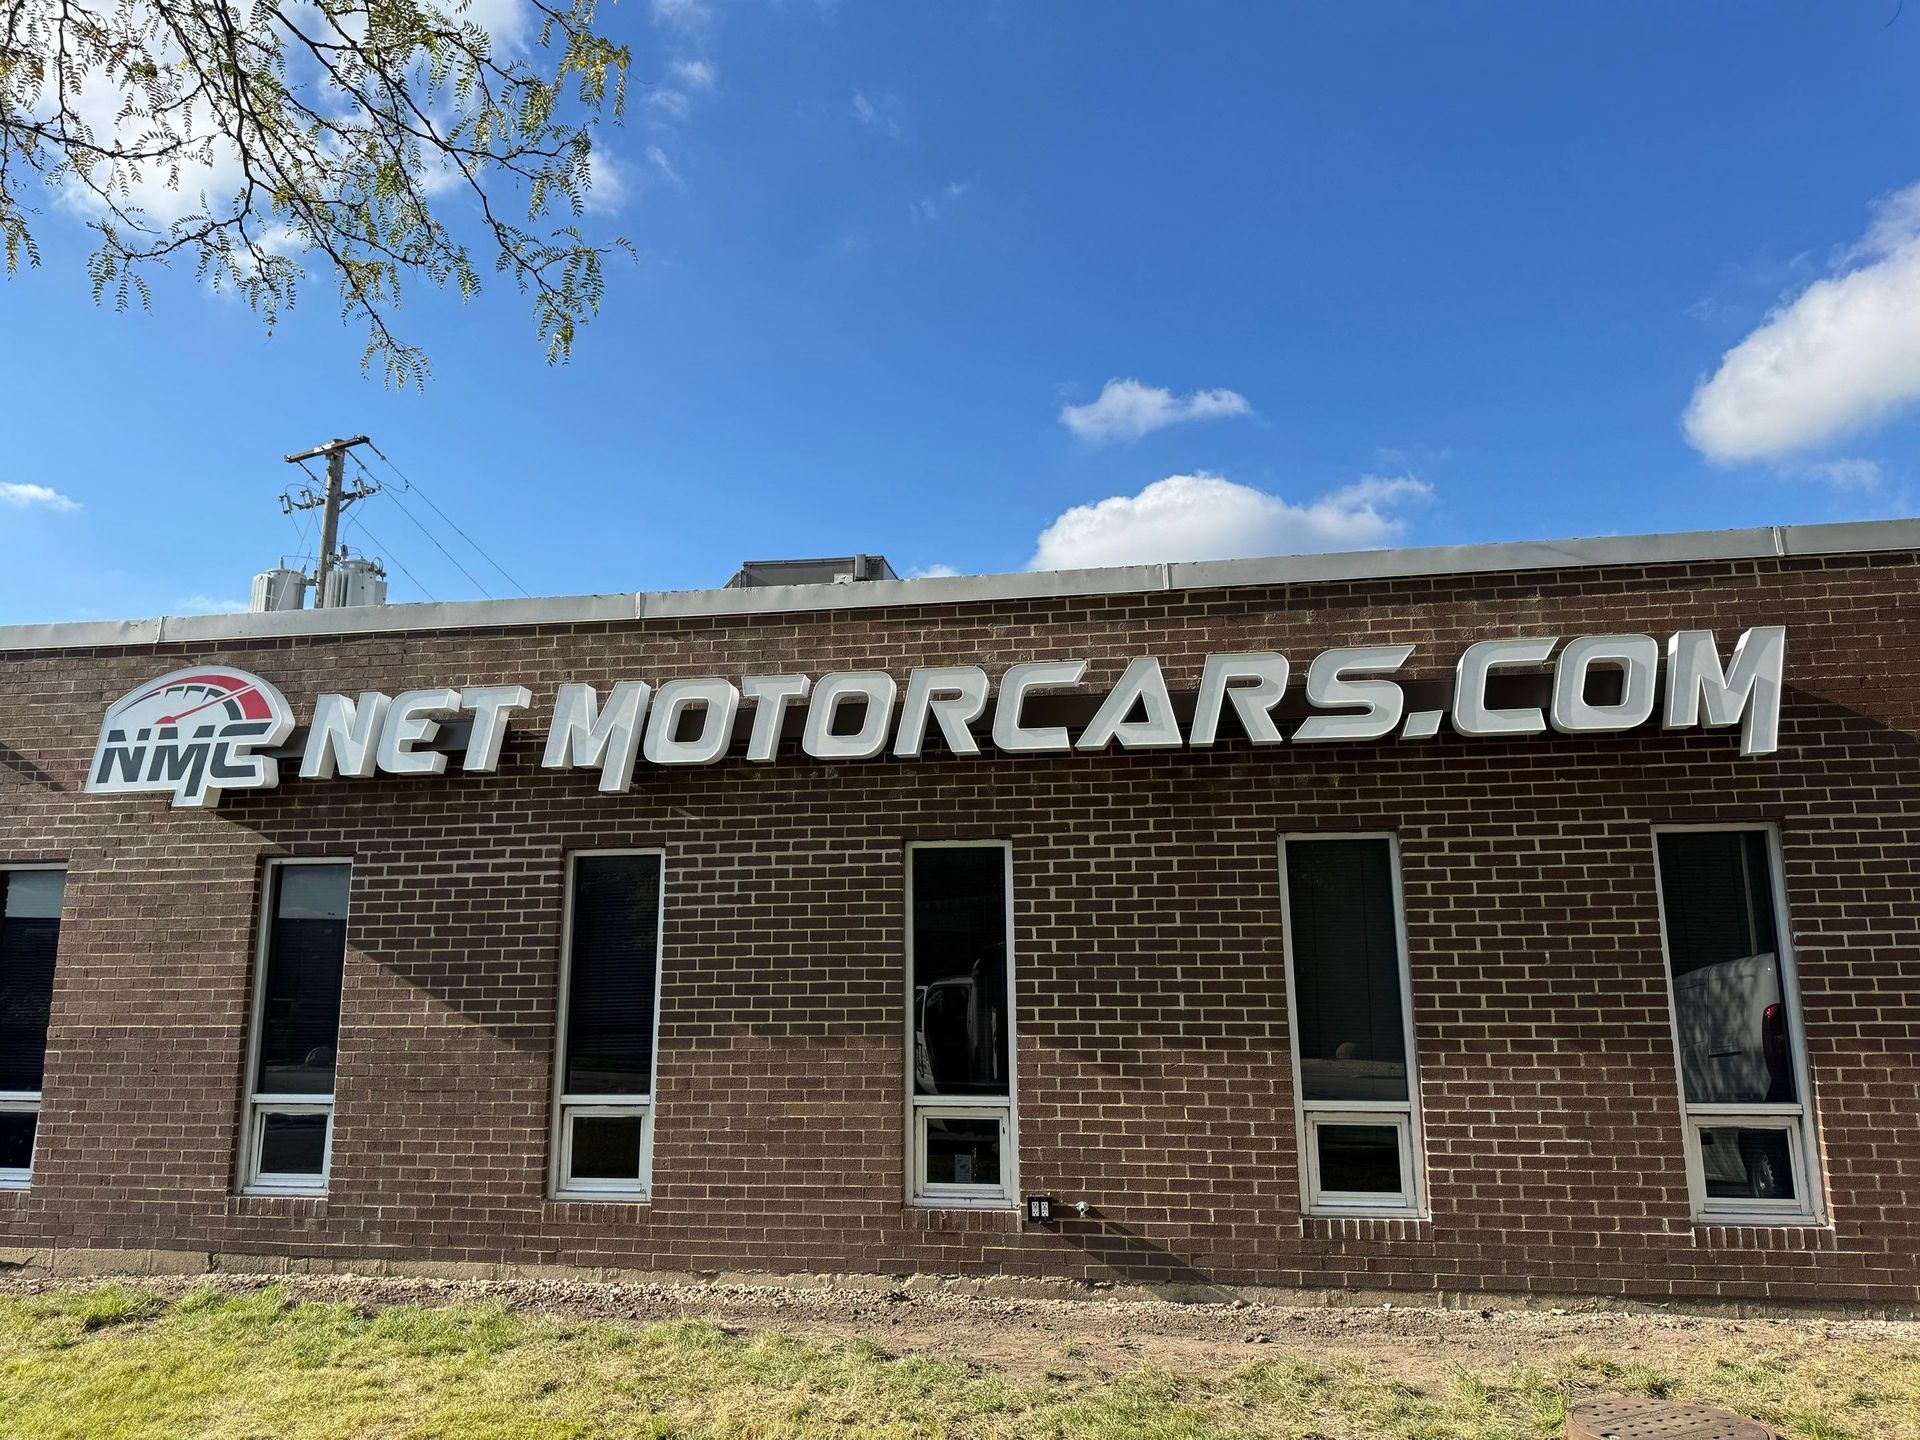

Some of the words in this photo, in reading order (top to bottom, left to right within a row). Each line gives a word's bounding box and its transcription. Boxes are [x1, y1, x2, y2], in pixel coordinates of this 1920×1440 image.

[96, 723, 272, 797] NMC
[299, 685, 532, 778] NET
[541, 625, 1786, 793] MOTORCARS.COM
